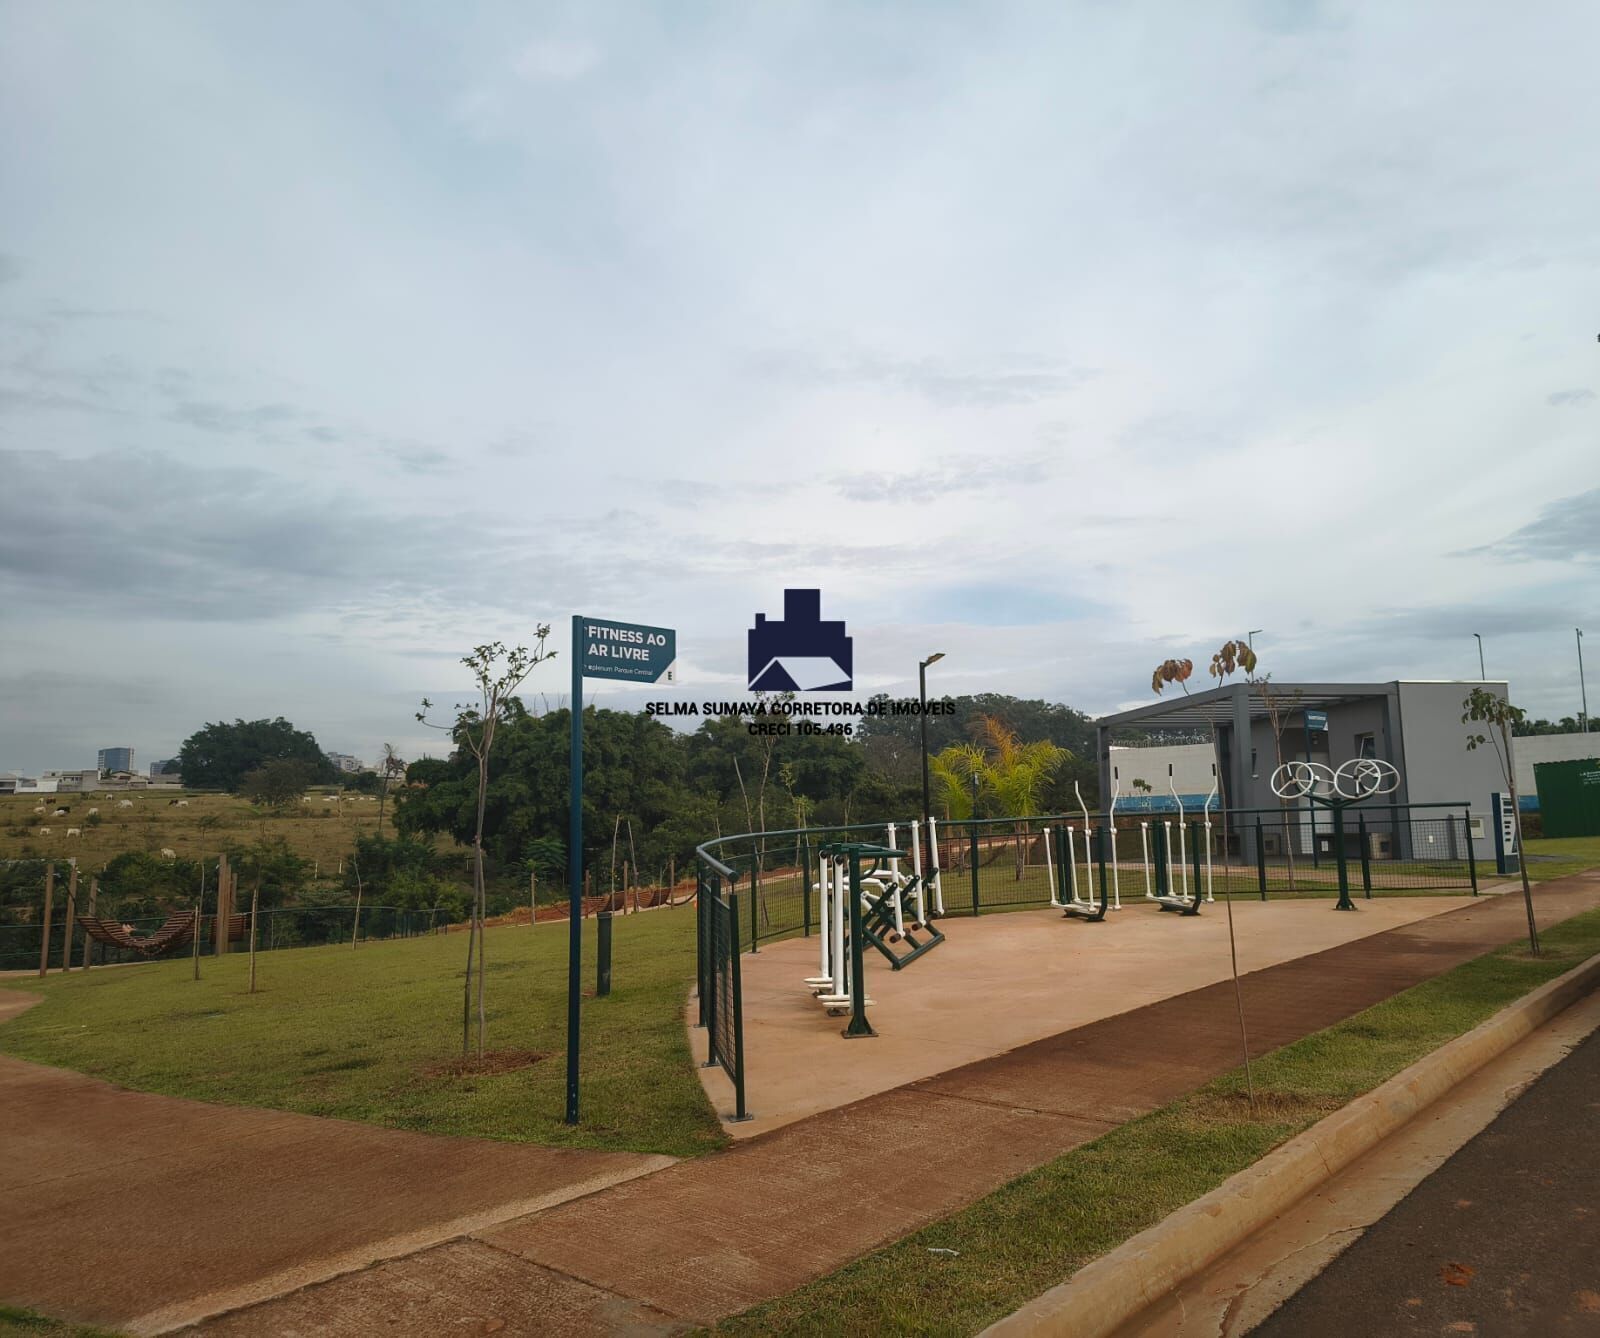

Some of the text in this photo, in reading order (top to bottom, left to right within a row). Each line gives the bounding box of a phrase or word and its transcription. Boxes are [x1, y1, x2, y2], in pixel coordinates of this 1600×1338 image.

[588, 626, 666, 647] FITNESS AO
[588, 643, 650, 661] AR LIVRE
